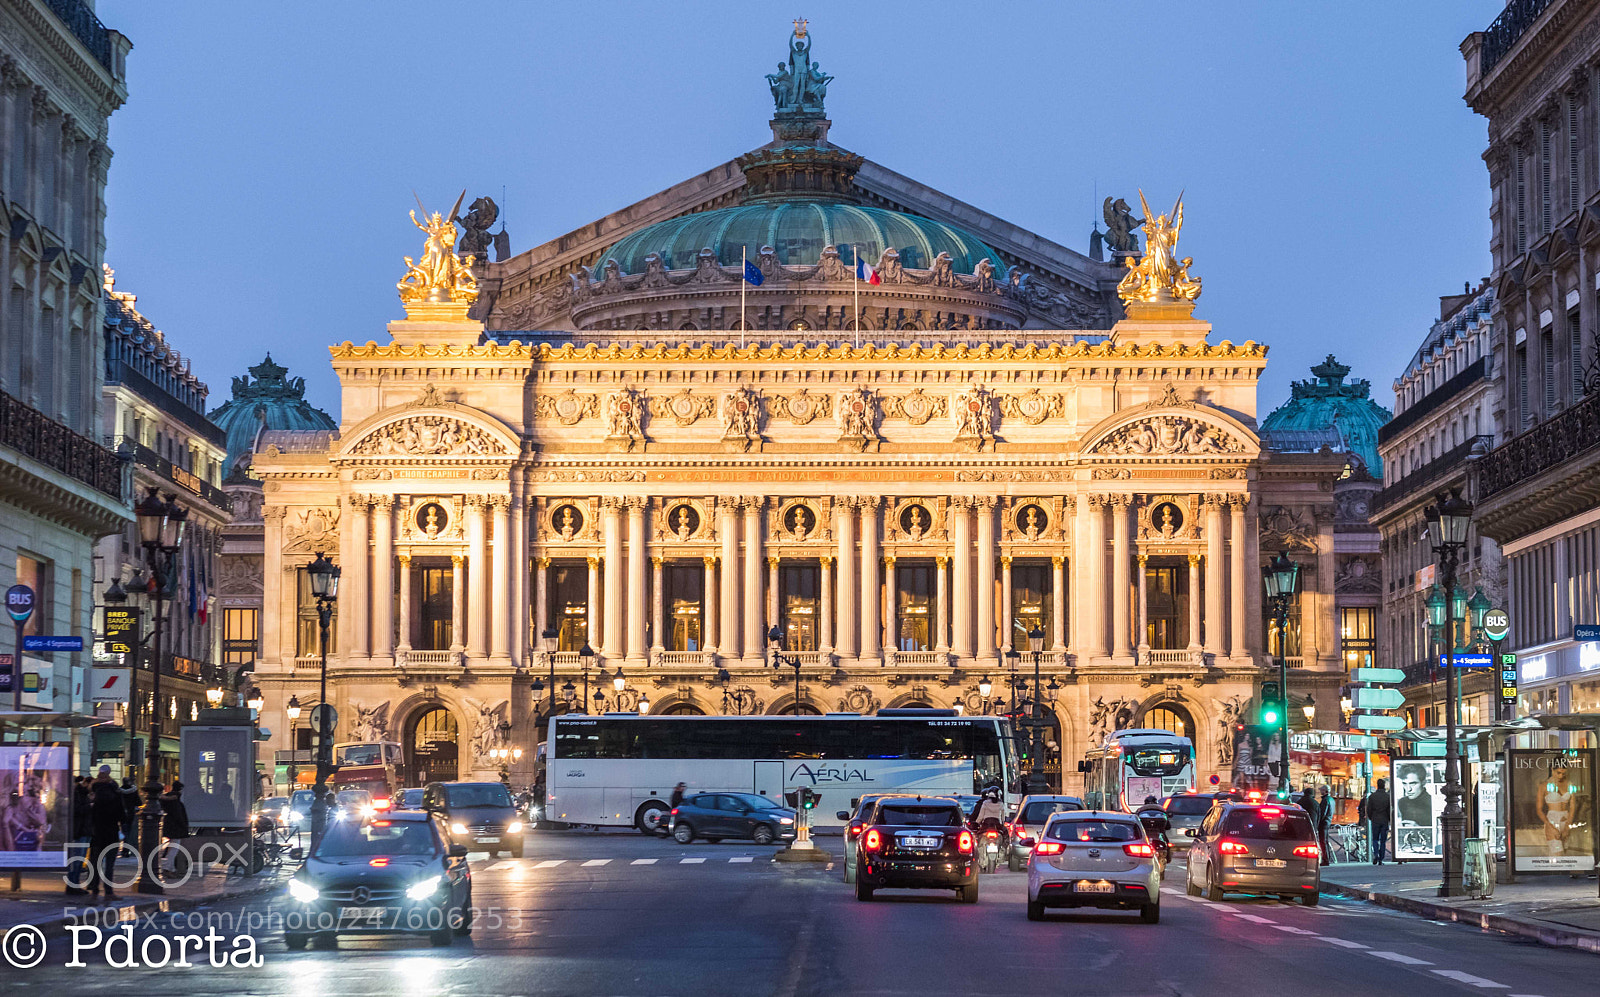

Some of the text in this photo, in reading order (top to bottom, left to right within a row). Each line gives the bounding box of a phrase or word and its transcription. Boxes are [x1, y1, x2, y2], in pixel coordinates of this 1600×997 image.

[9, 593, 32, 604] BUS
[1486, 616, 1506, 627] BUS
[1576, 629, 1594, 637] Opéra
[1515, 757, 1534, 769] LISE
